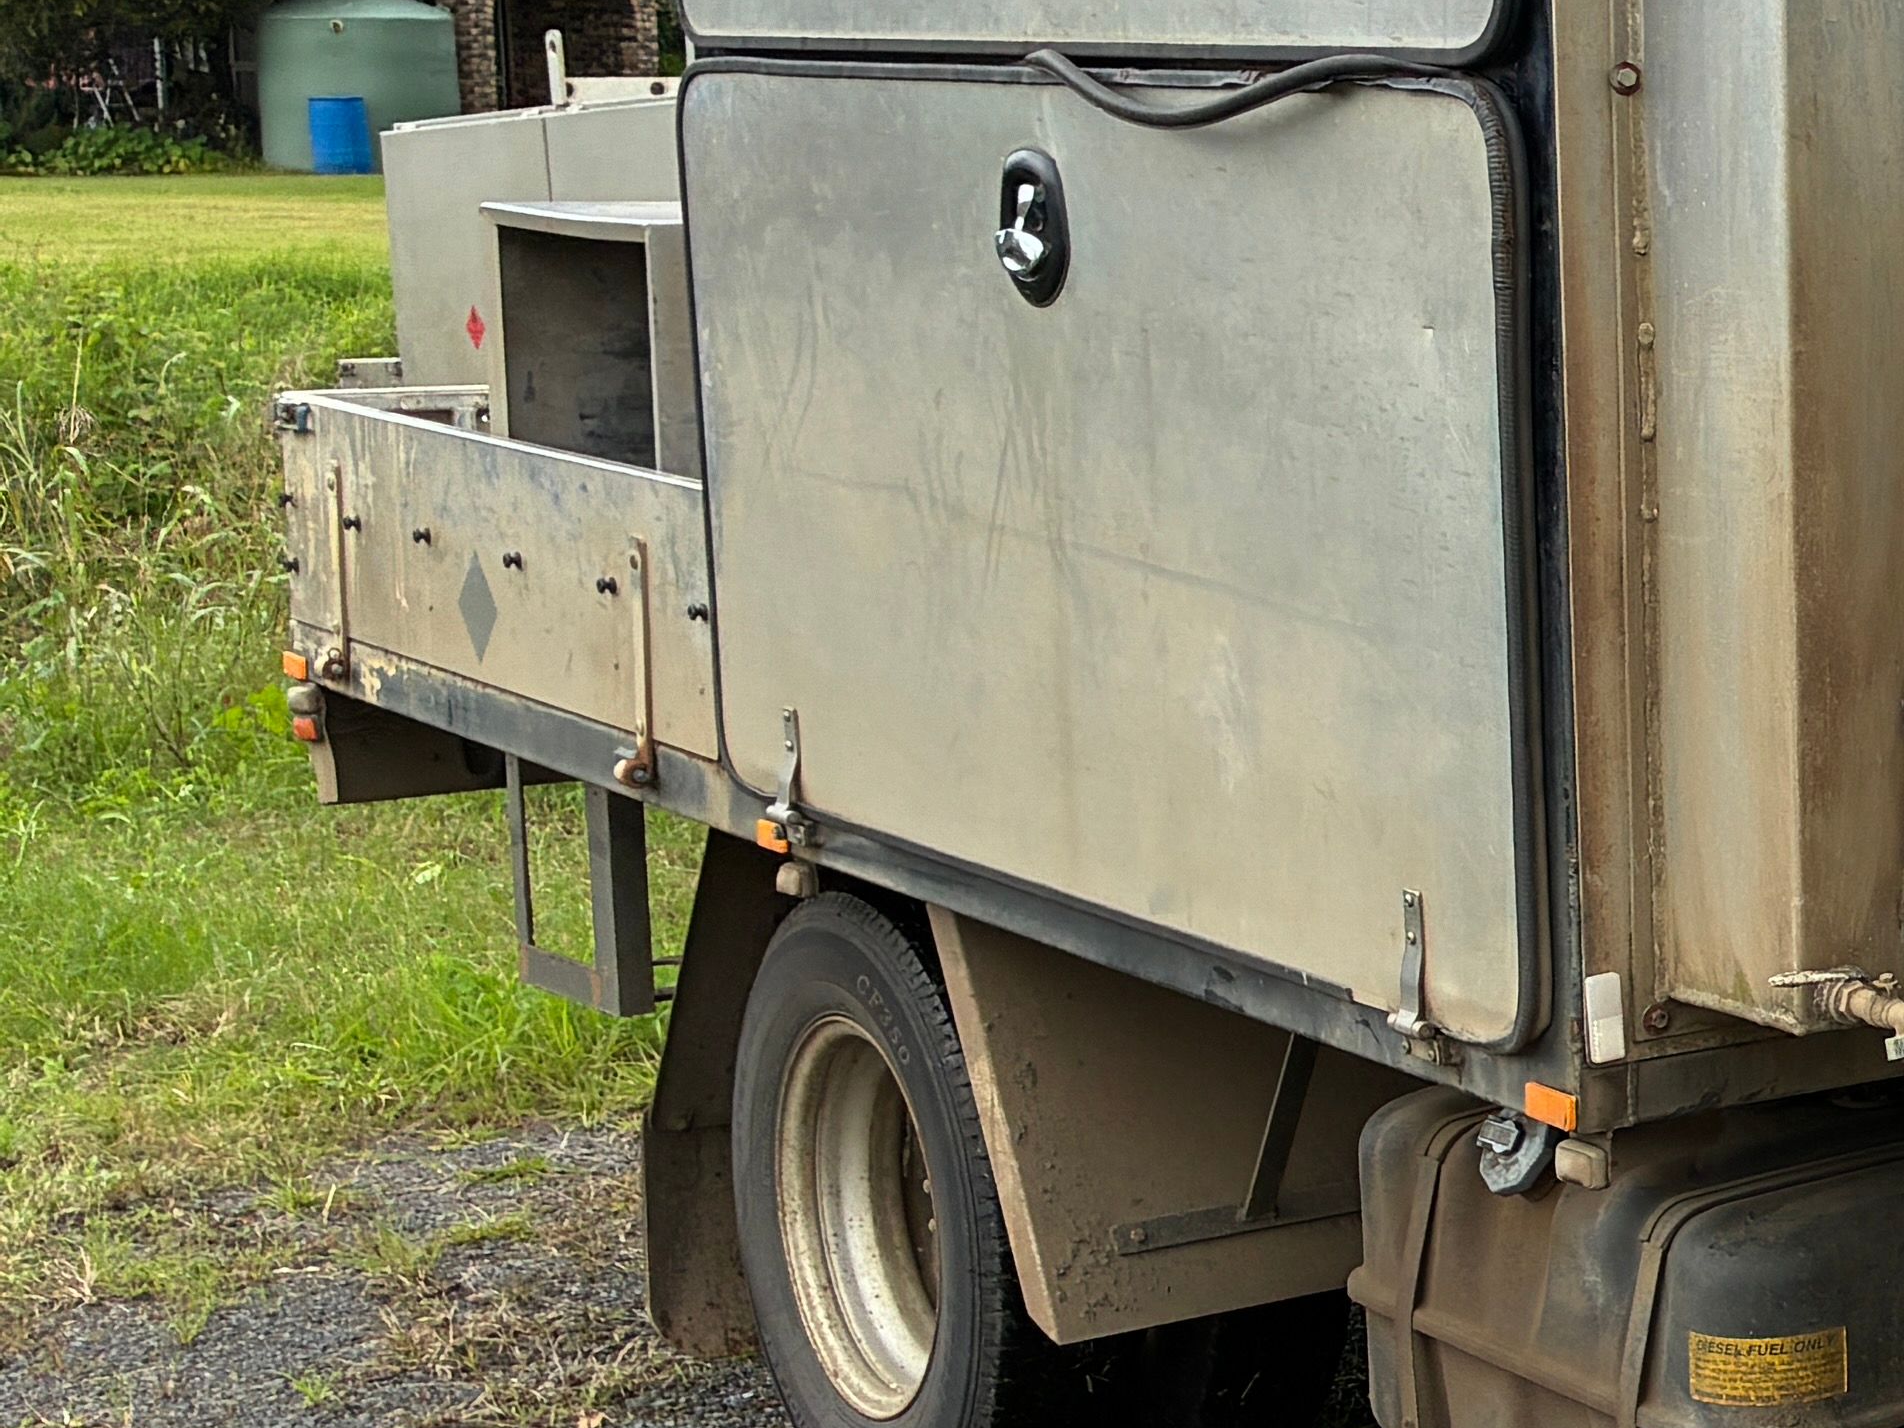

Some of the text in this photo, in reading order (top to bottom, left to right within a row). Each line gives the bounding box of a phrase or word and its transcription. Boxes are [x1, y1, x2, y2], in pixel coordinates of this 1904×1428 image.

[1696, 1335, 1836, 1357] DIESEL FUEL ONLY
